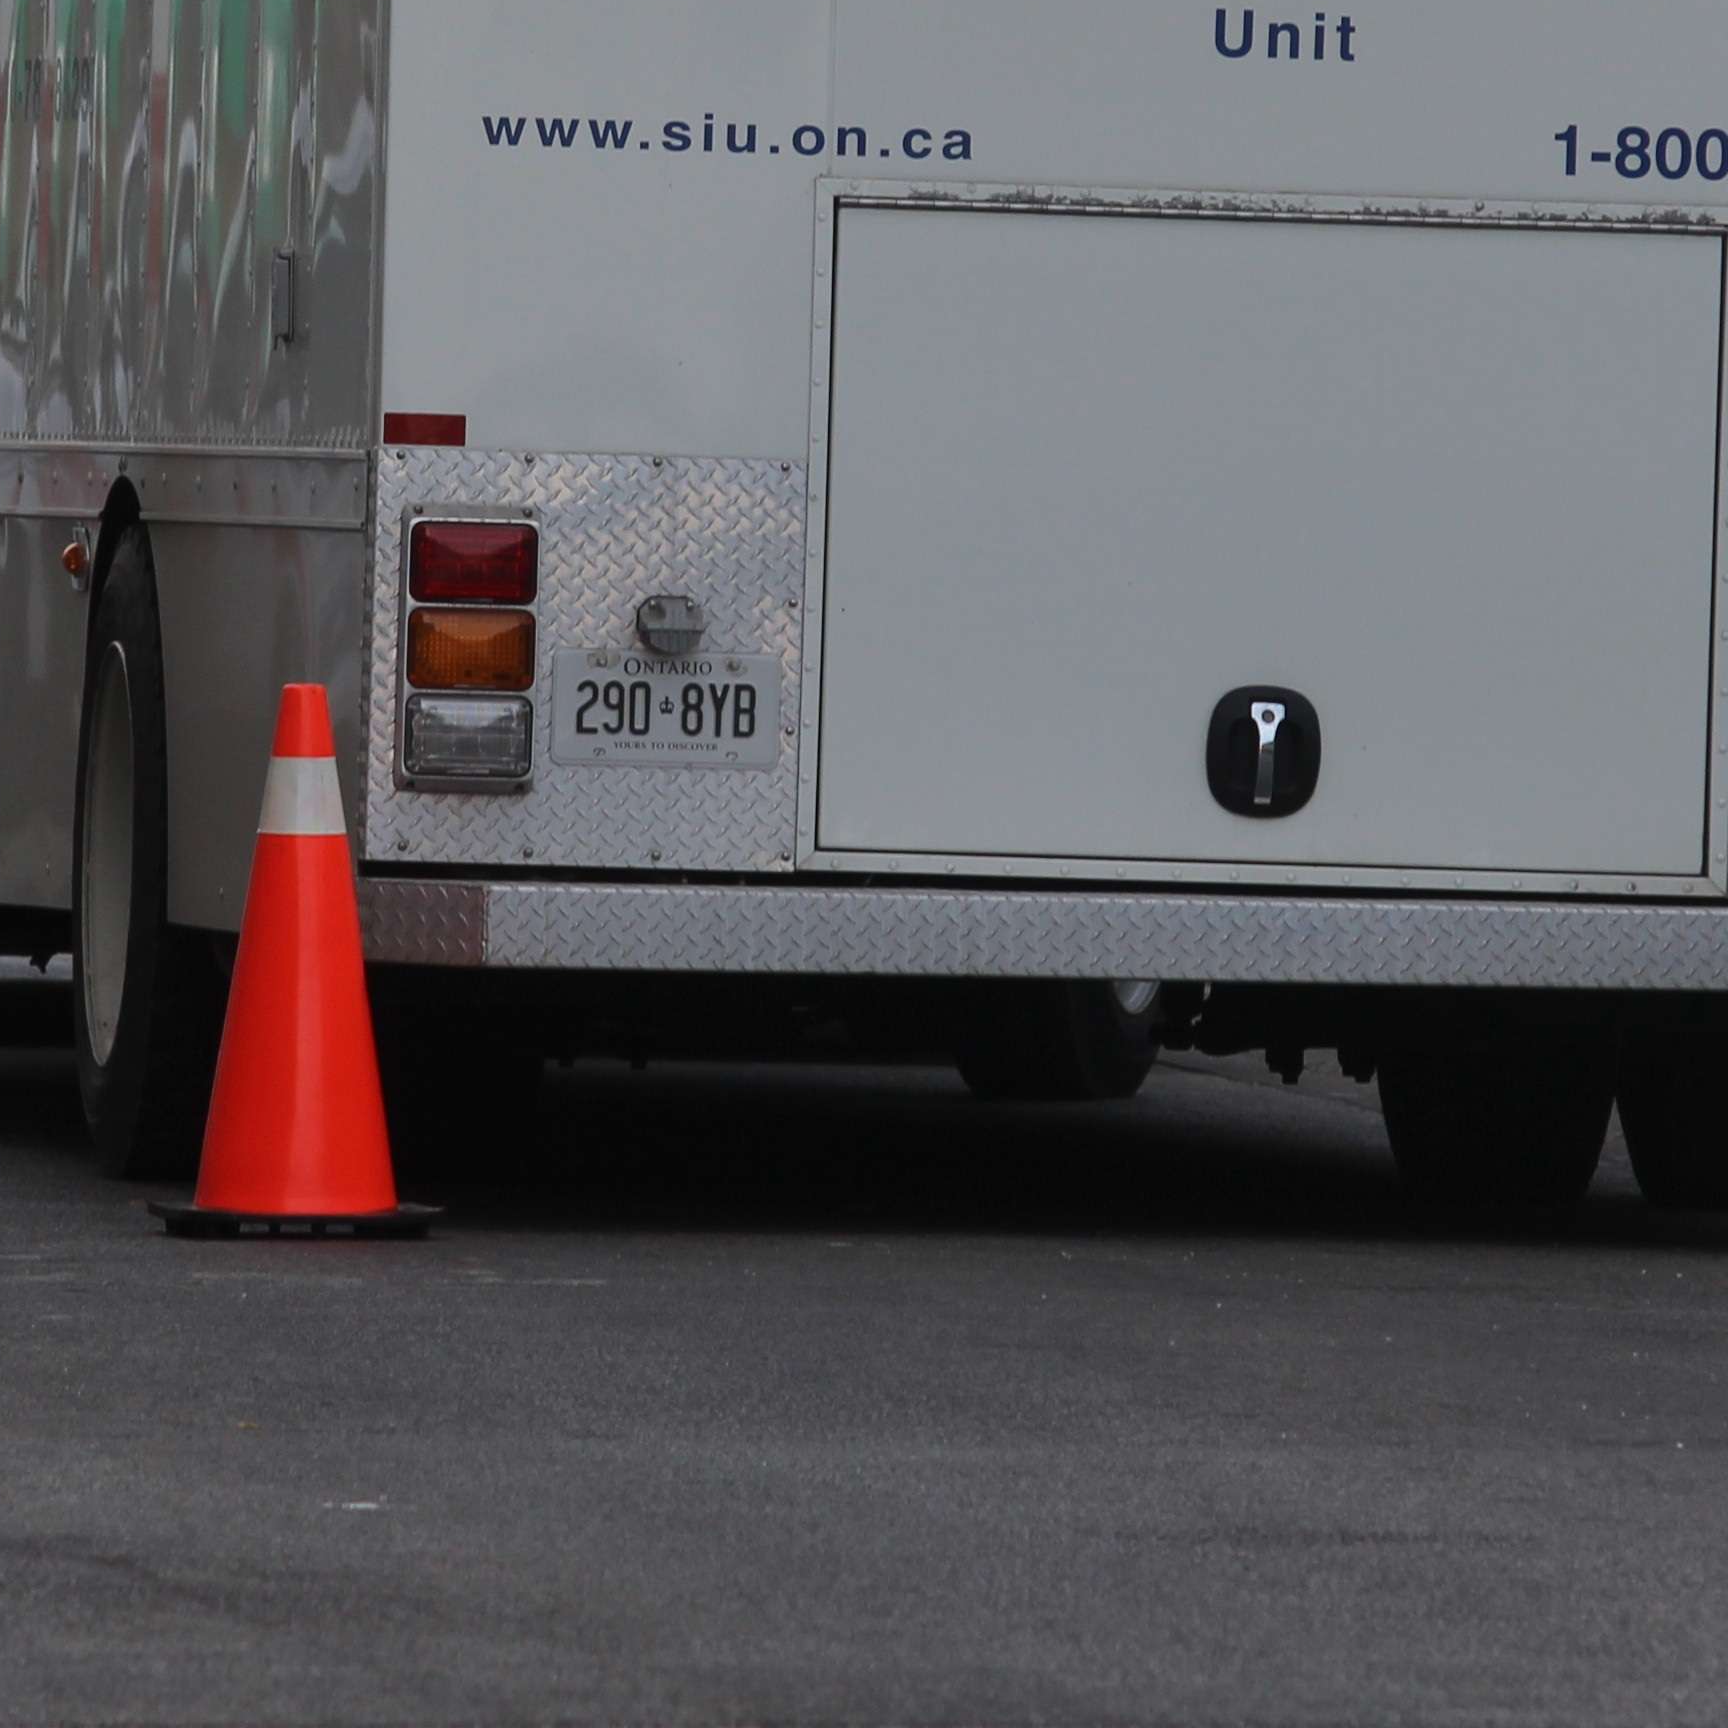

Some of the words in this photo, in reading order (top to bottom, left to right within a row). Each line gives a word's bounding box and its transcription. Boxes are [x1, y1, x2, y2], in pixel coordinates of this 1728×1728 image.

[1214, 8, 1355, 62] Unit
[483, 112, 972, 161] www.siu.on.ca
[623, 657, 713, 677] ONTARIO
[575, 679, 652, 736] 290
[680, 682, 757, 739] 8YB
[613, 740, 647, 751] YOURS
[650, 741, 665, 751] TO
[667, 741, 719, 753] DISCOVER
